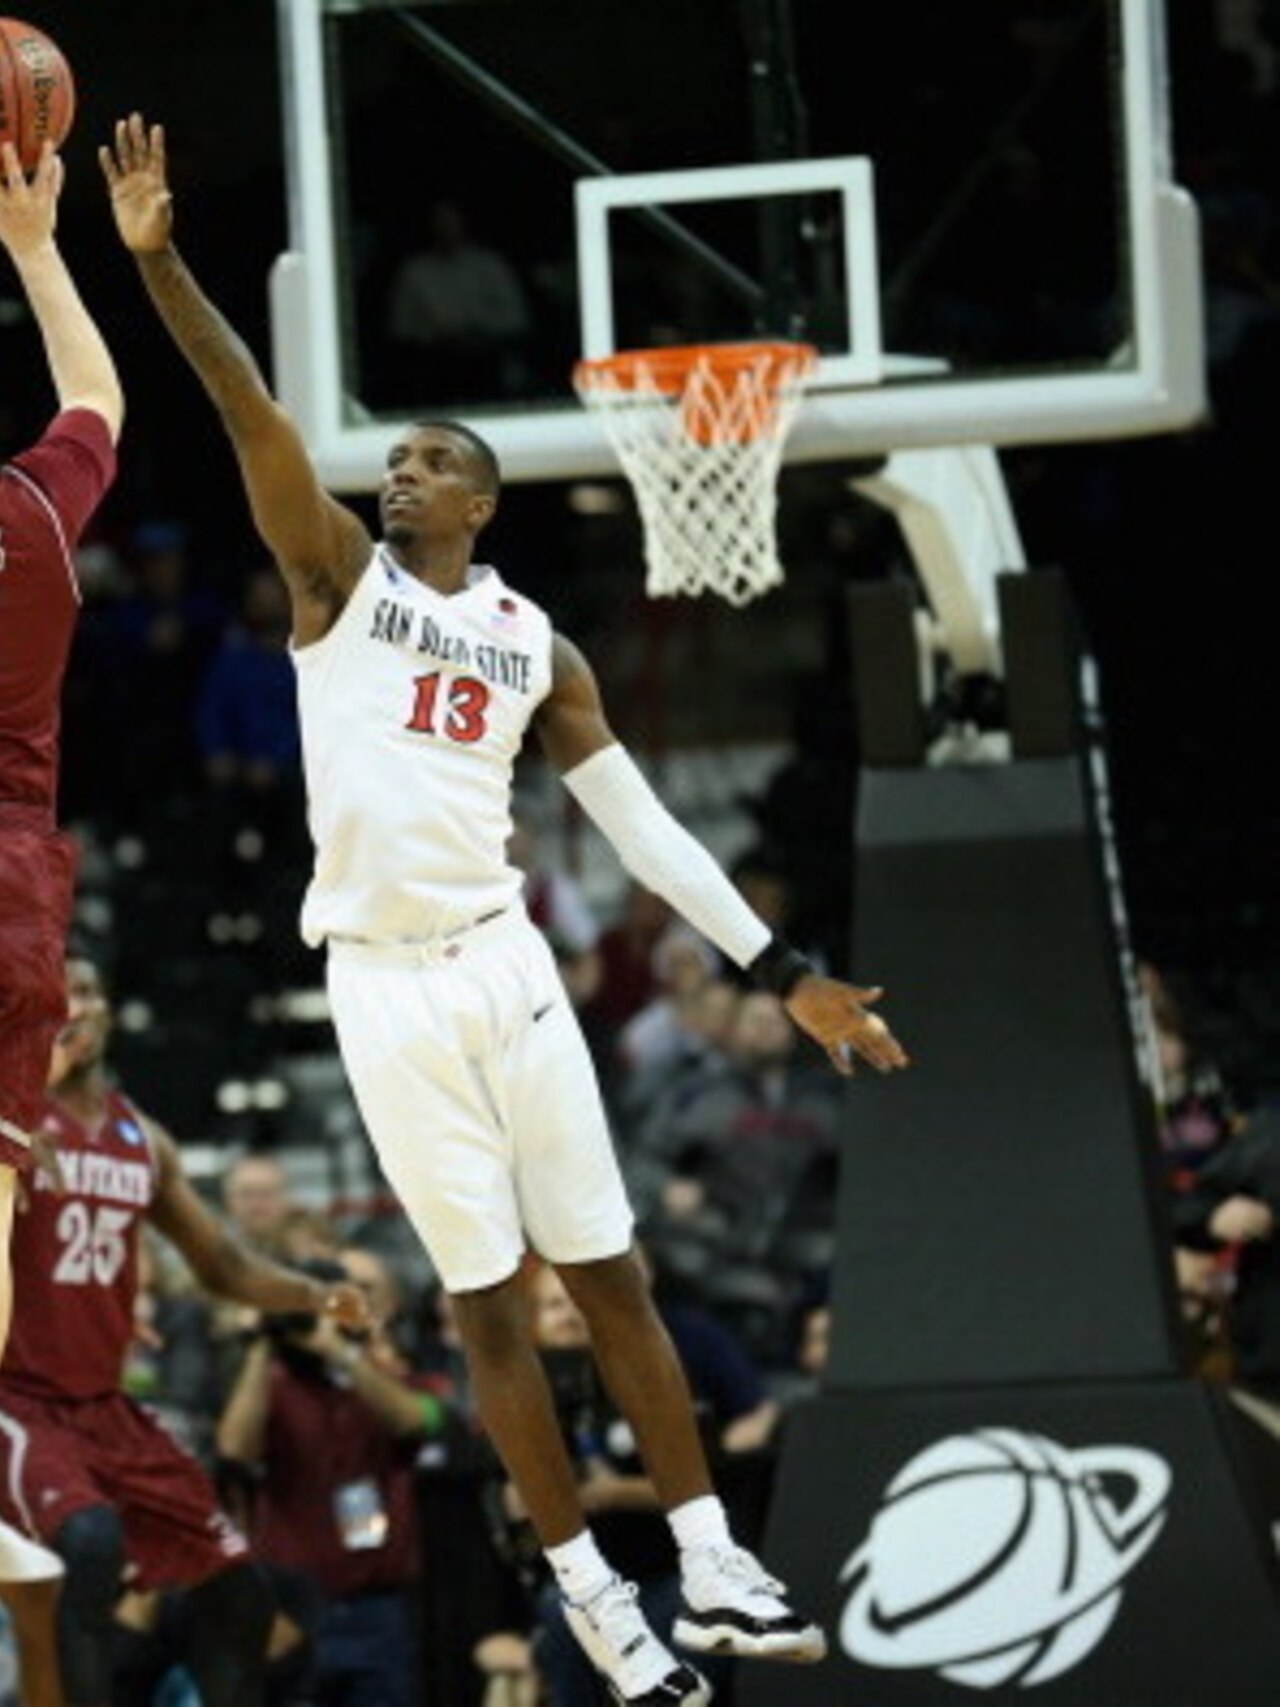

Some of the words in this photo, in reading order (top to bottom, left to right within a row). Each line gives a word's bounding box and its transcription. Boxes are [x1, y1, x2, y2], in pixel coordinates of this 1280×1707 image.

[370, 598, 414, 641] SAN
[476, 645, 531, 695] STATE
[405, 671, 489, 742] 13
[51, 1200, 133, 1286] 25
